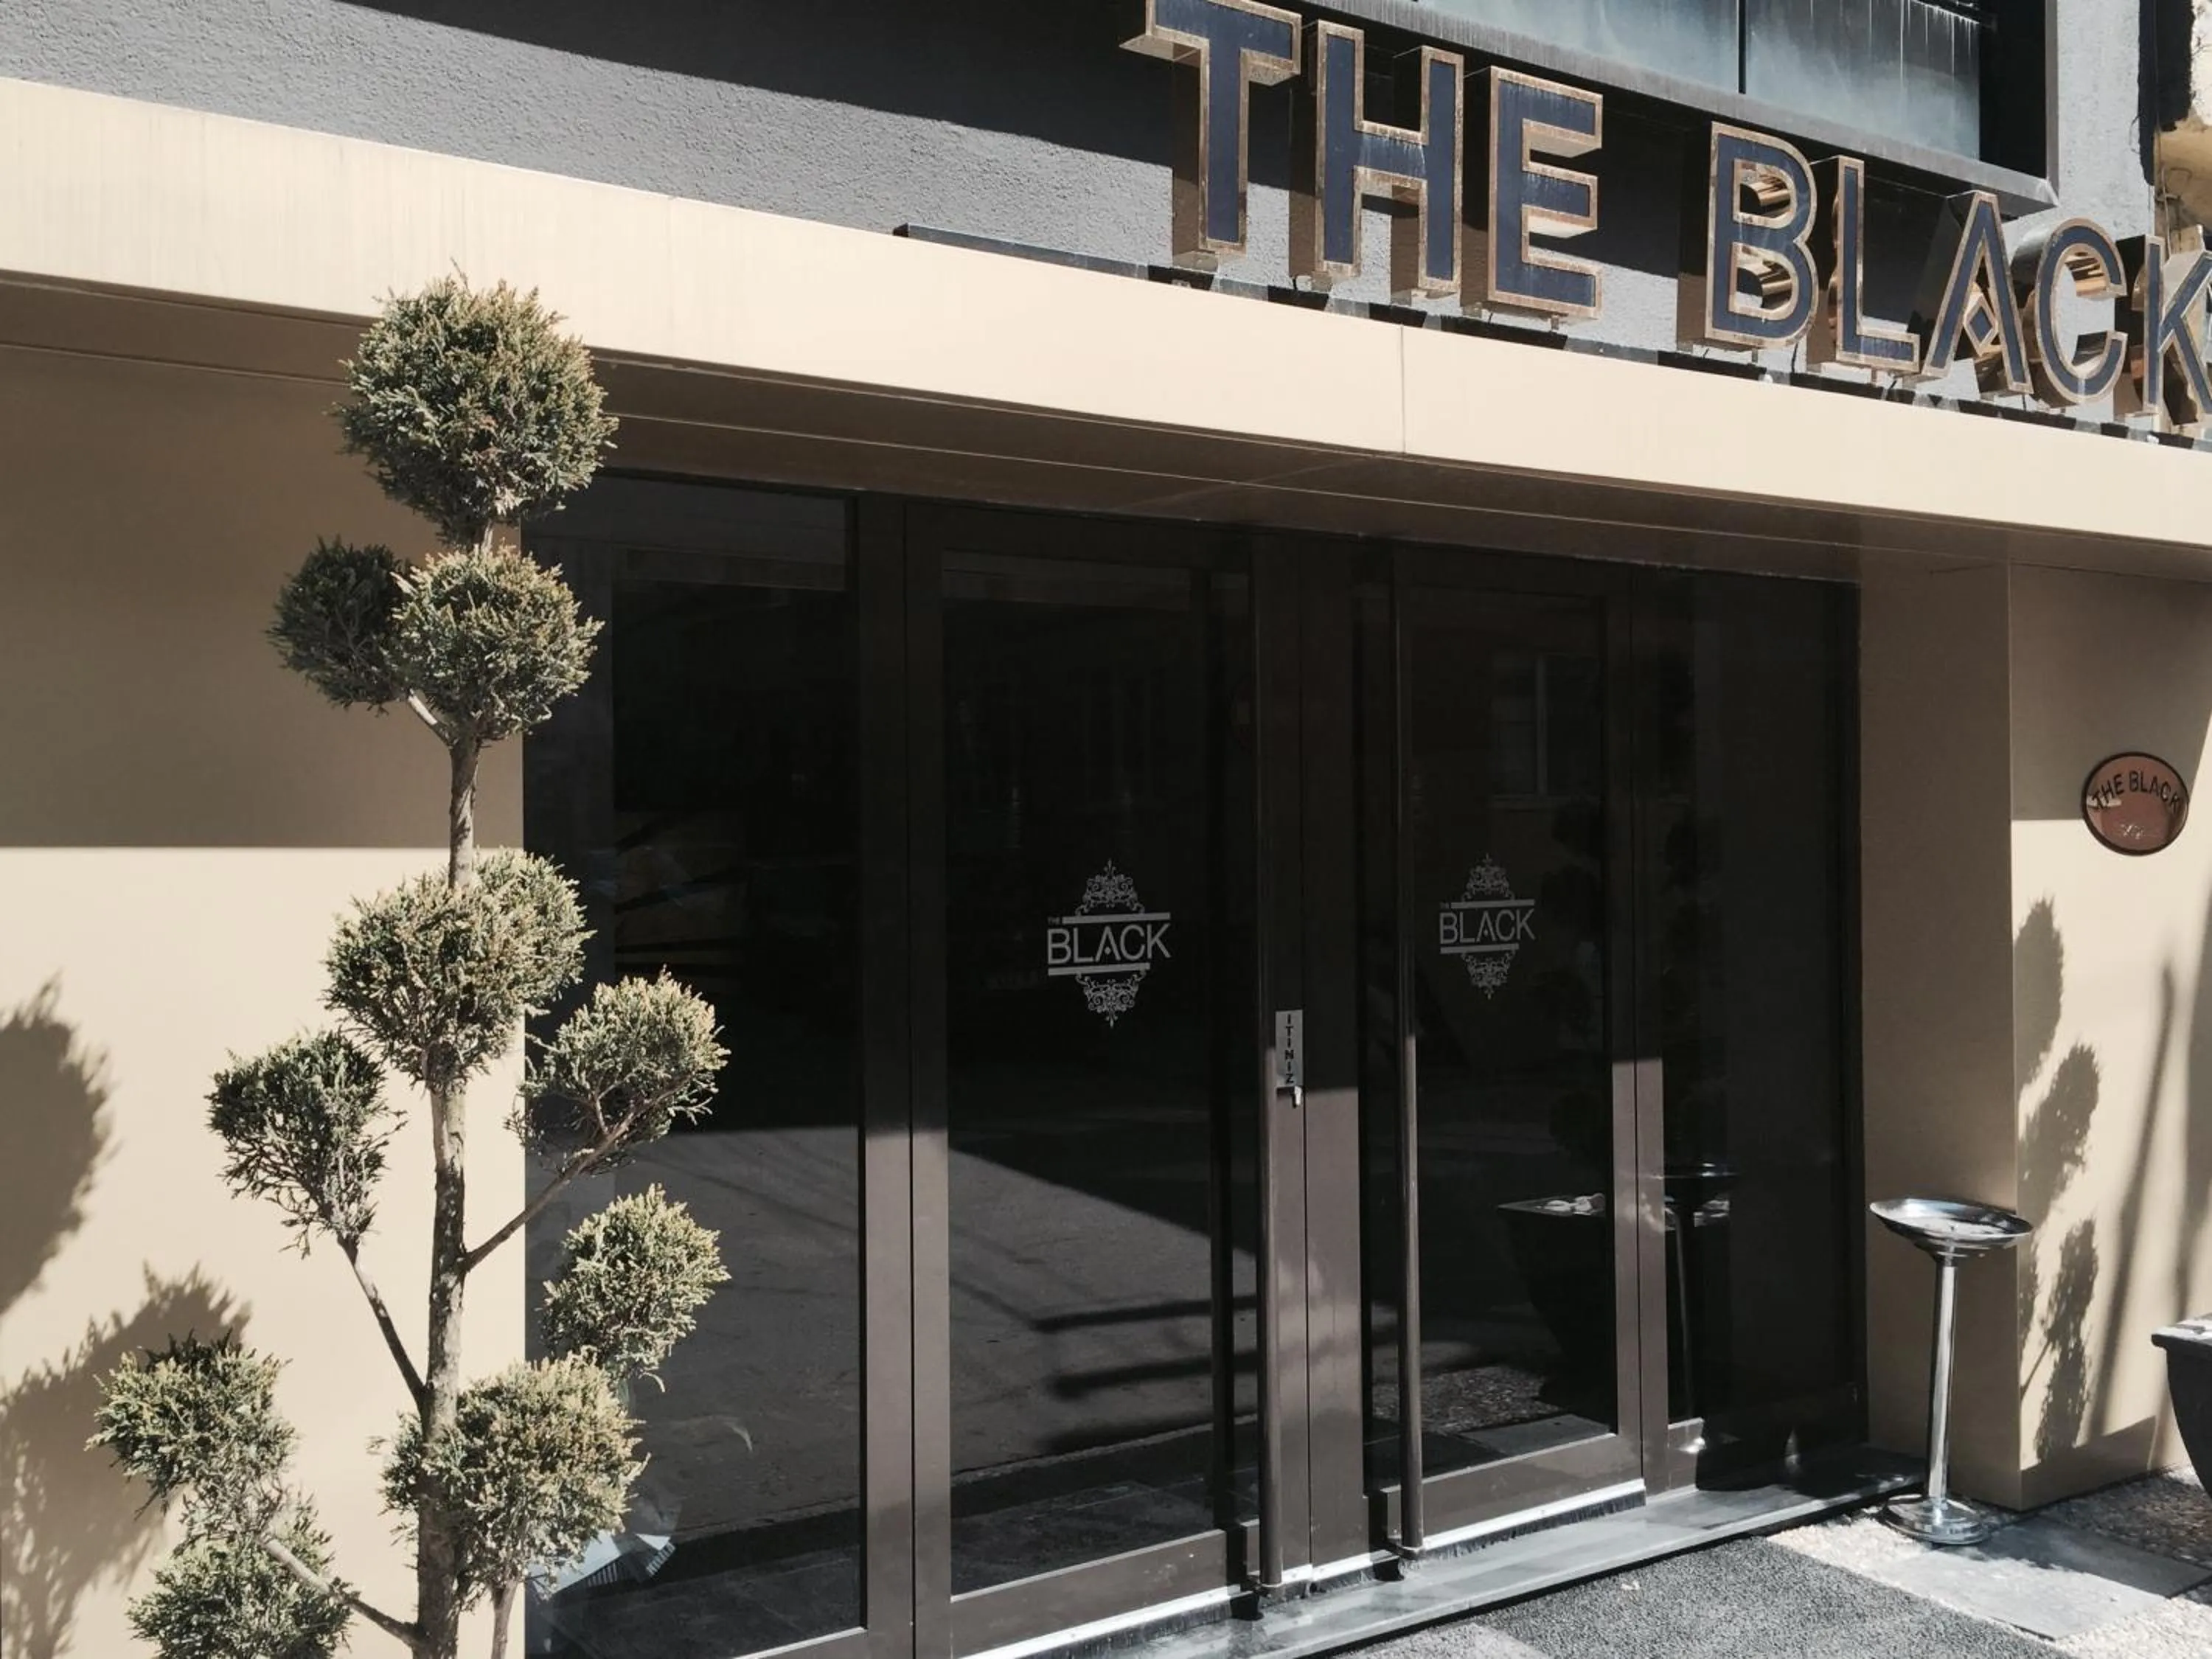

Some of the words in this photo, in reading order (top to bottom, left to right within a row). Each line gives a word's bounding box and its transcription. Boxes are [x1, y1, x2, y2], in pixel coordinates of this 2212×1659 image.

[1141, 0, 1603, 319] THE
[1705, 121, 2212, 417] BLACK
[2092, 773, 2125, 810] THE
[2129, 771, 2180, 813] BLACK
[1047, 923, 1171, 964] BLACK
[1439, 908, 1536, 944] BLACK
